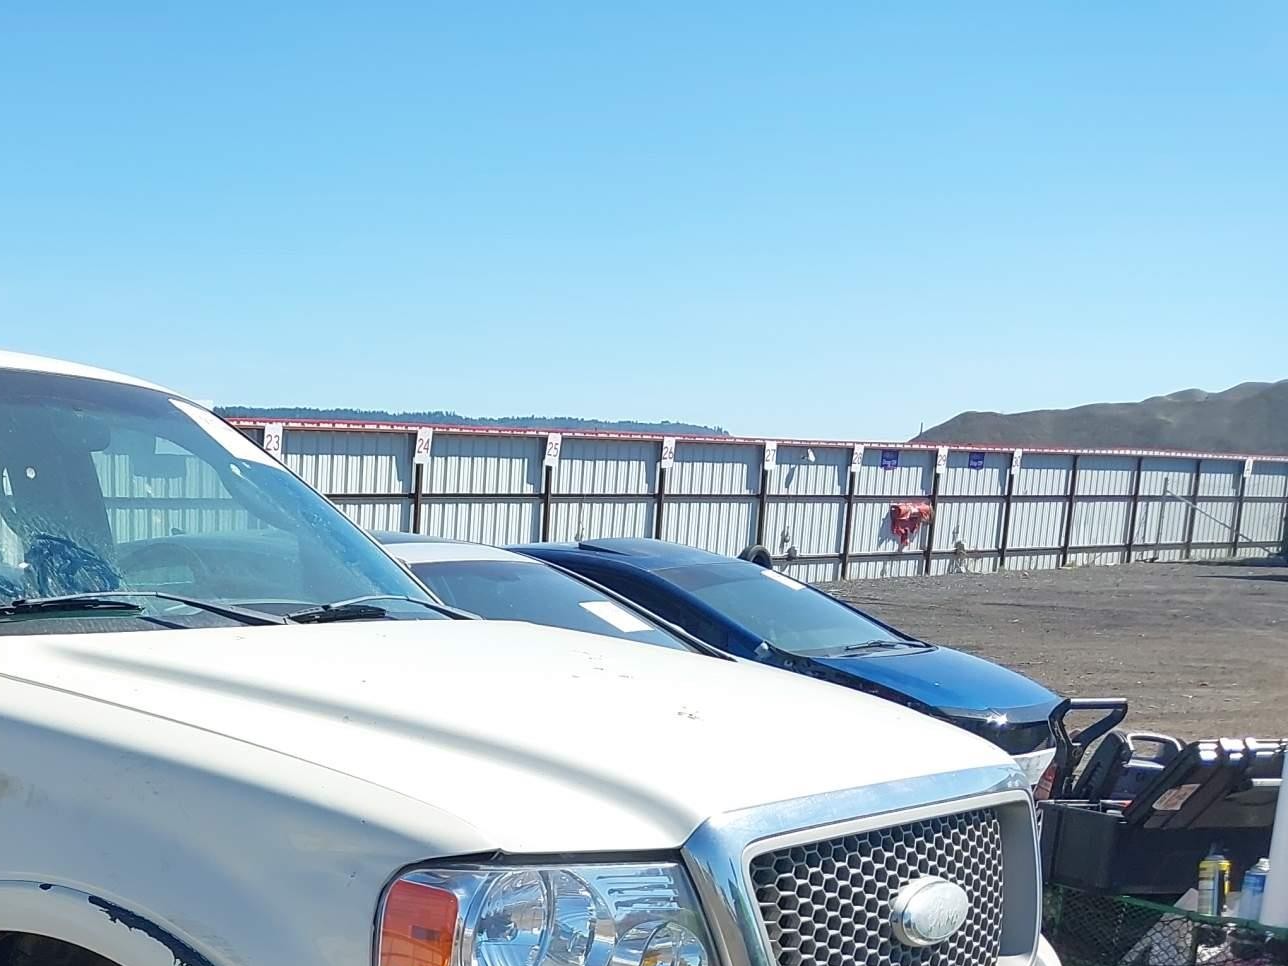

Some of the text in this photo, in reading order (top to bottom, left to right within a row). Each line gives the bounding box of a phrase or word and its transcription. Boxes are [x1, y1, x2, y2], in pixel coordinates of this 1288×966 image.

[265, 434, 280, 451] 23
[417, 438, 430, 454] 24
[546, 441, 559, 457] 25
[662, 445, 674, 460] 26
[765, 449, 776, 462] 27
